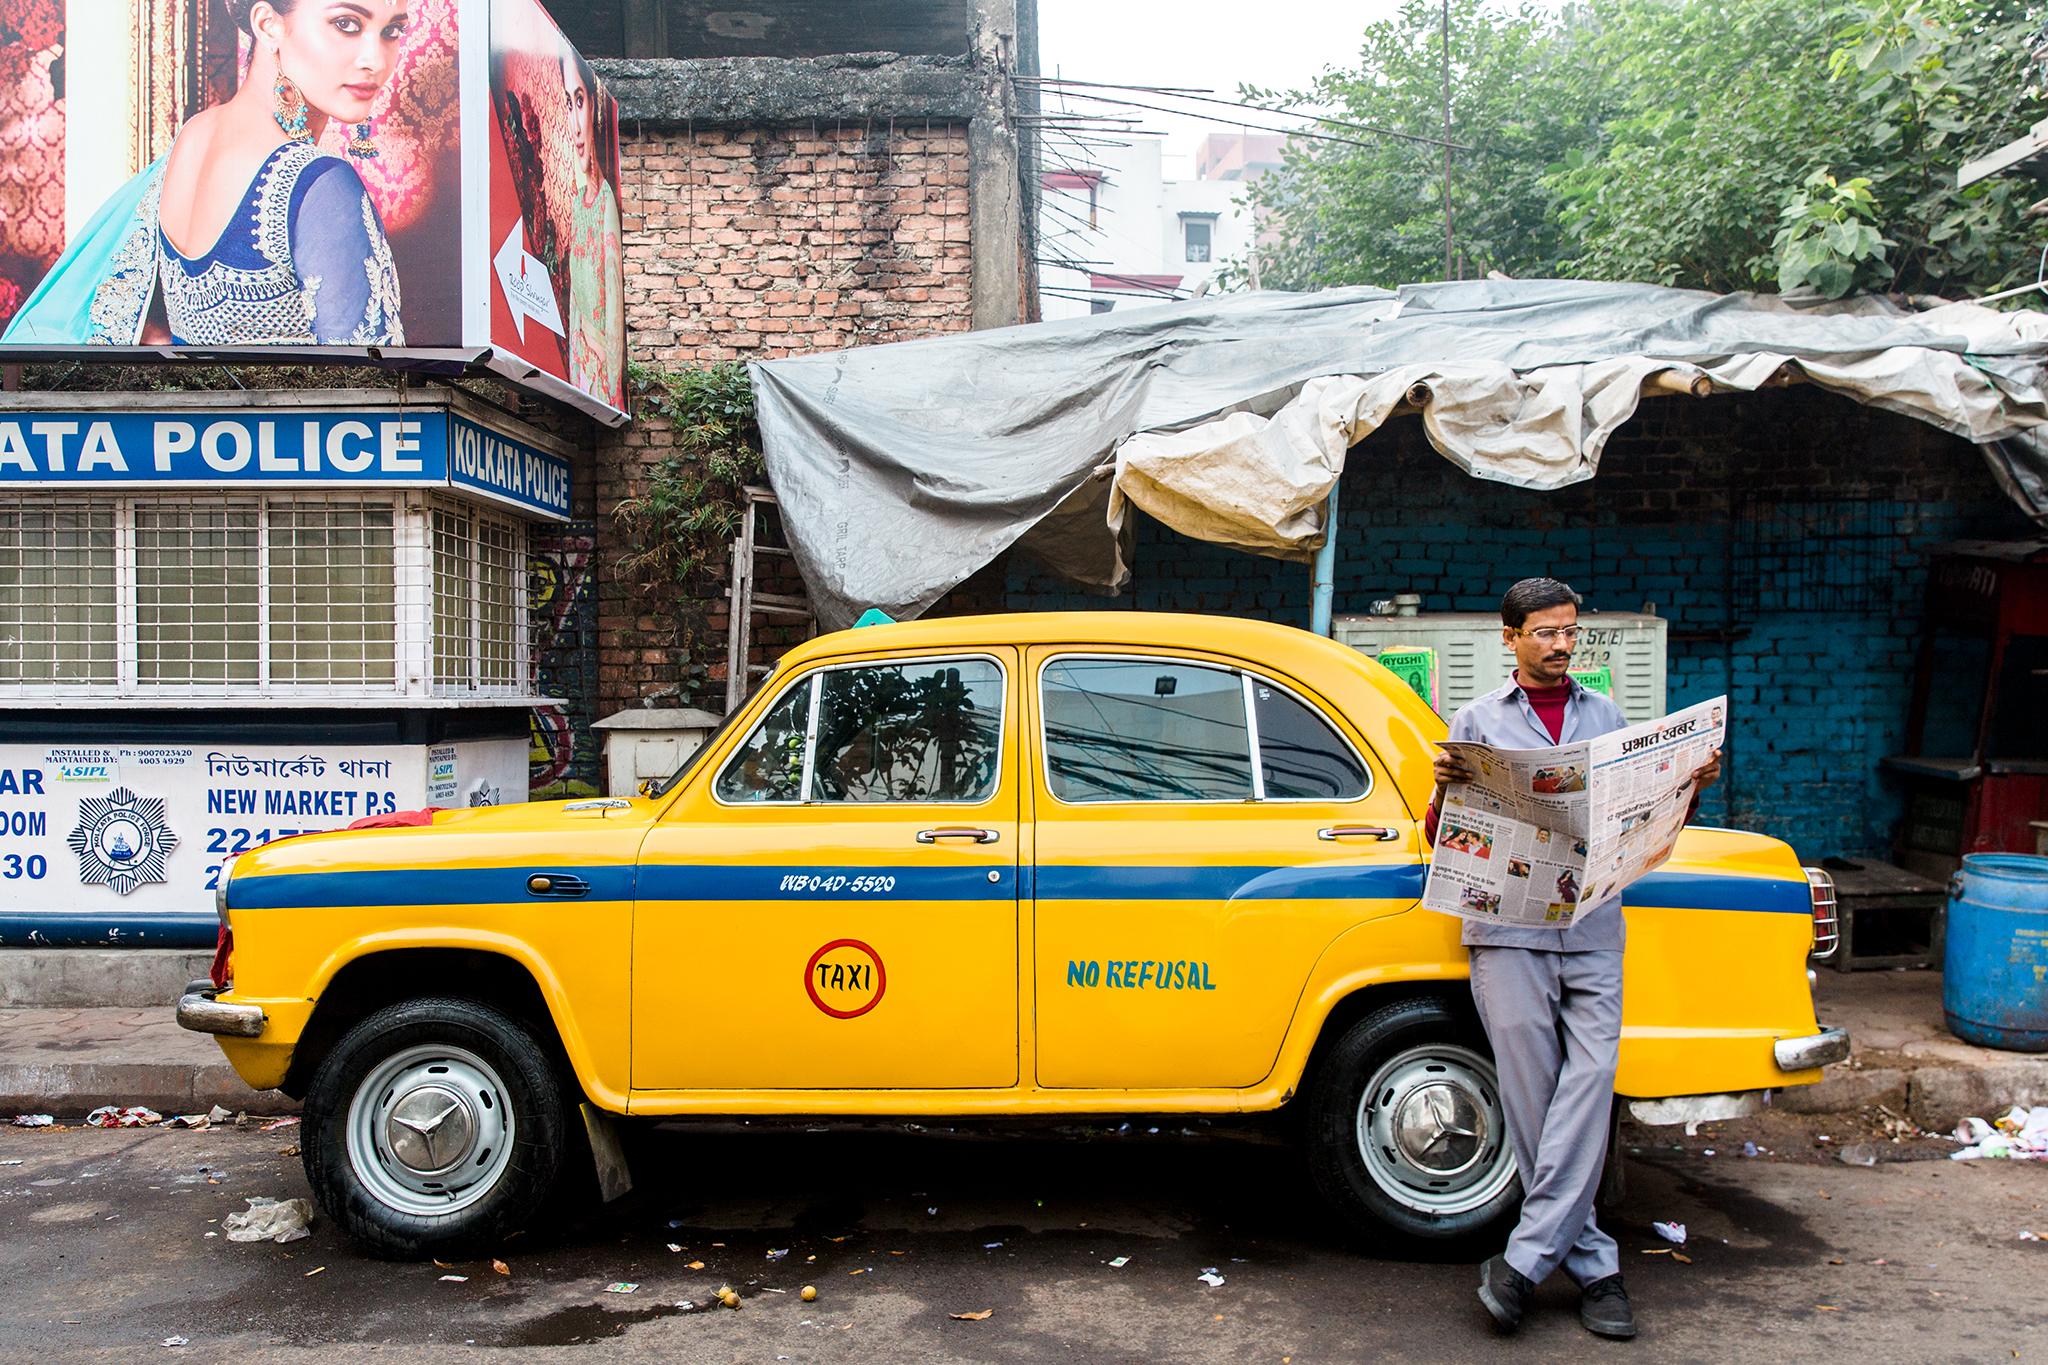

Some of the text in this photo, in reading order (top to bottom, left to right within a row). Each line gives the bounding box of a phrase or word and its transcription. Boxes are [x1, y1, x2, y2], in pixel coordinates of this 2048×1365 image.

[0, 421, 423, 473] ATA POLICE
[454, 423, 568, 510] KOLKATA POLICE
[834, 545, 847, 569] TARP
[1383, 656, 1422, 666] AYUSHI
[1621, 718, 1697, 755] प्रभात खबर
[45, 756, 118, 764] MAINTAINED BY:
[51, 749, 111, 757] INSTALLED &
[119, 749, 132, 757] Ph
[137, 749, 193, 758] 9007023420
[138, 757, 185, 765] 4003 4929
[205, 751, 392, 779] নিউমার্কেট থানা
[0, 769, 45, 794] AR
[72, 766, 109, 777] SIPL
[207, 788, 397, 817] NEW MARKET P.S
[93, 811, 151, 848] KOLKATA POLICE FORCE
[3, 854, 47, 880] 30
[816, 963, 871, 992] TAXI
[1066, 959, 1217, 991] NO REFUSAL
